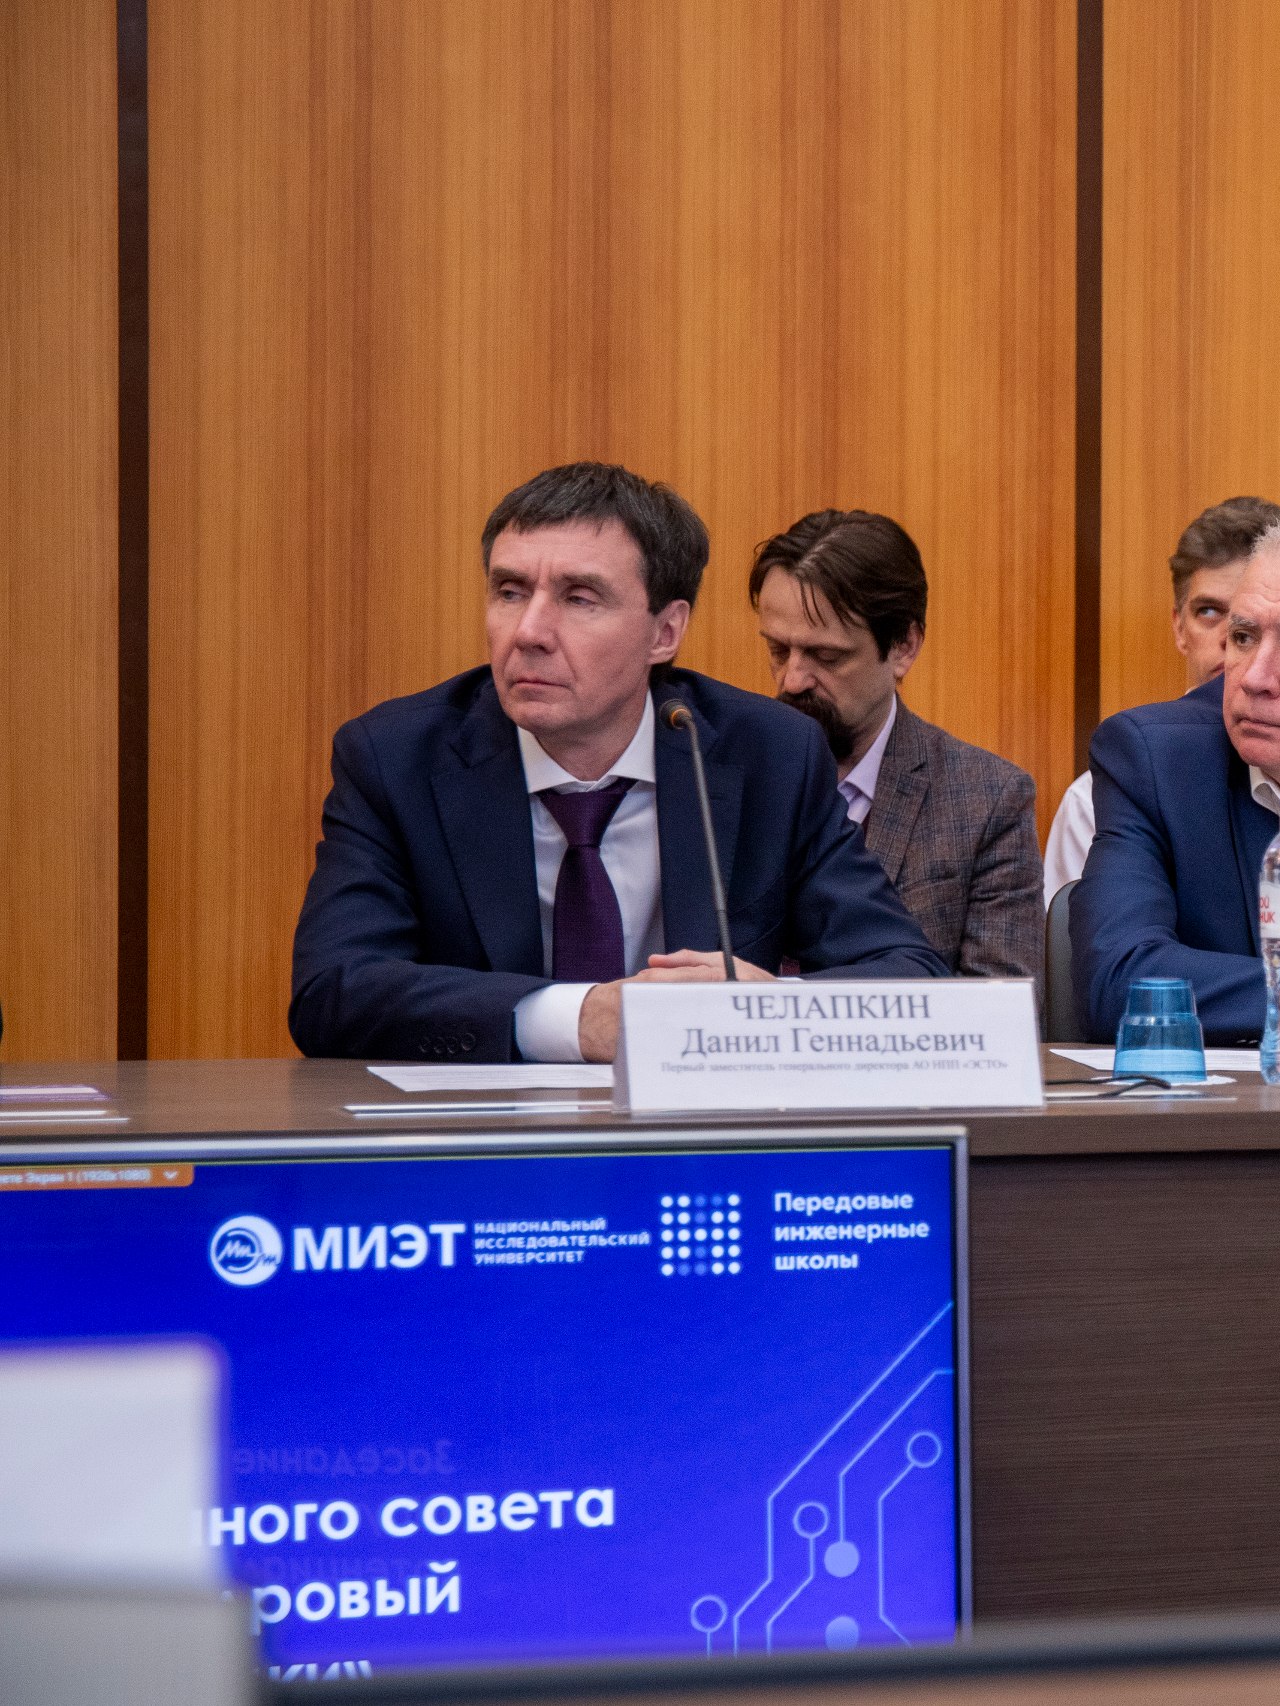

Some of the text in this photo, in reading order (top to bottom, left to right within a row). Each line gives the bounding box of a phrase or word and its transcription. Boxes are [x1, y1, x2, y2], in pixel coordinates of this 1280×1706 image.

[732, 995, 931, 1020] ЧЕЛАПКИН
[681, 1027, 986, 1059] Данил Геннадьевич
[661, 1062, 705, 1073] Первый
[709, 1063, 776, 1072] заместитель
[779, 1062, 852, 1073] генерального
[855, 1061, 909, 1073] директора
[912, 1060, 929, 1070] АО
[774, 1192, 914, 1216] Передовые
[474, 1217, 607, 1235] НАЦИОНАЛЬНЫЙ
[774, 1222, 930, 1244] инженерные
[292, 1223, 466, 1272] МИЭТ
[474, 1231, 650, 1250] ИССЛЕДОВАТЕЛЬСКИЙ
[474, 1250, 585, 1266] УНИВЕРСИТЕТ
[774, 1253, 859, 1271] школы
[193, 1486, 615, 1546] ного совета
[250, 1560, 460, 1636] ровый
